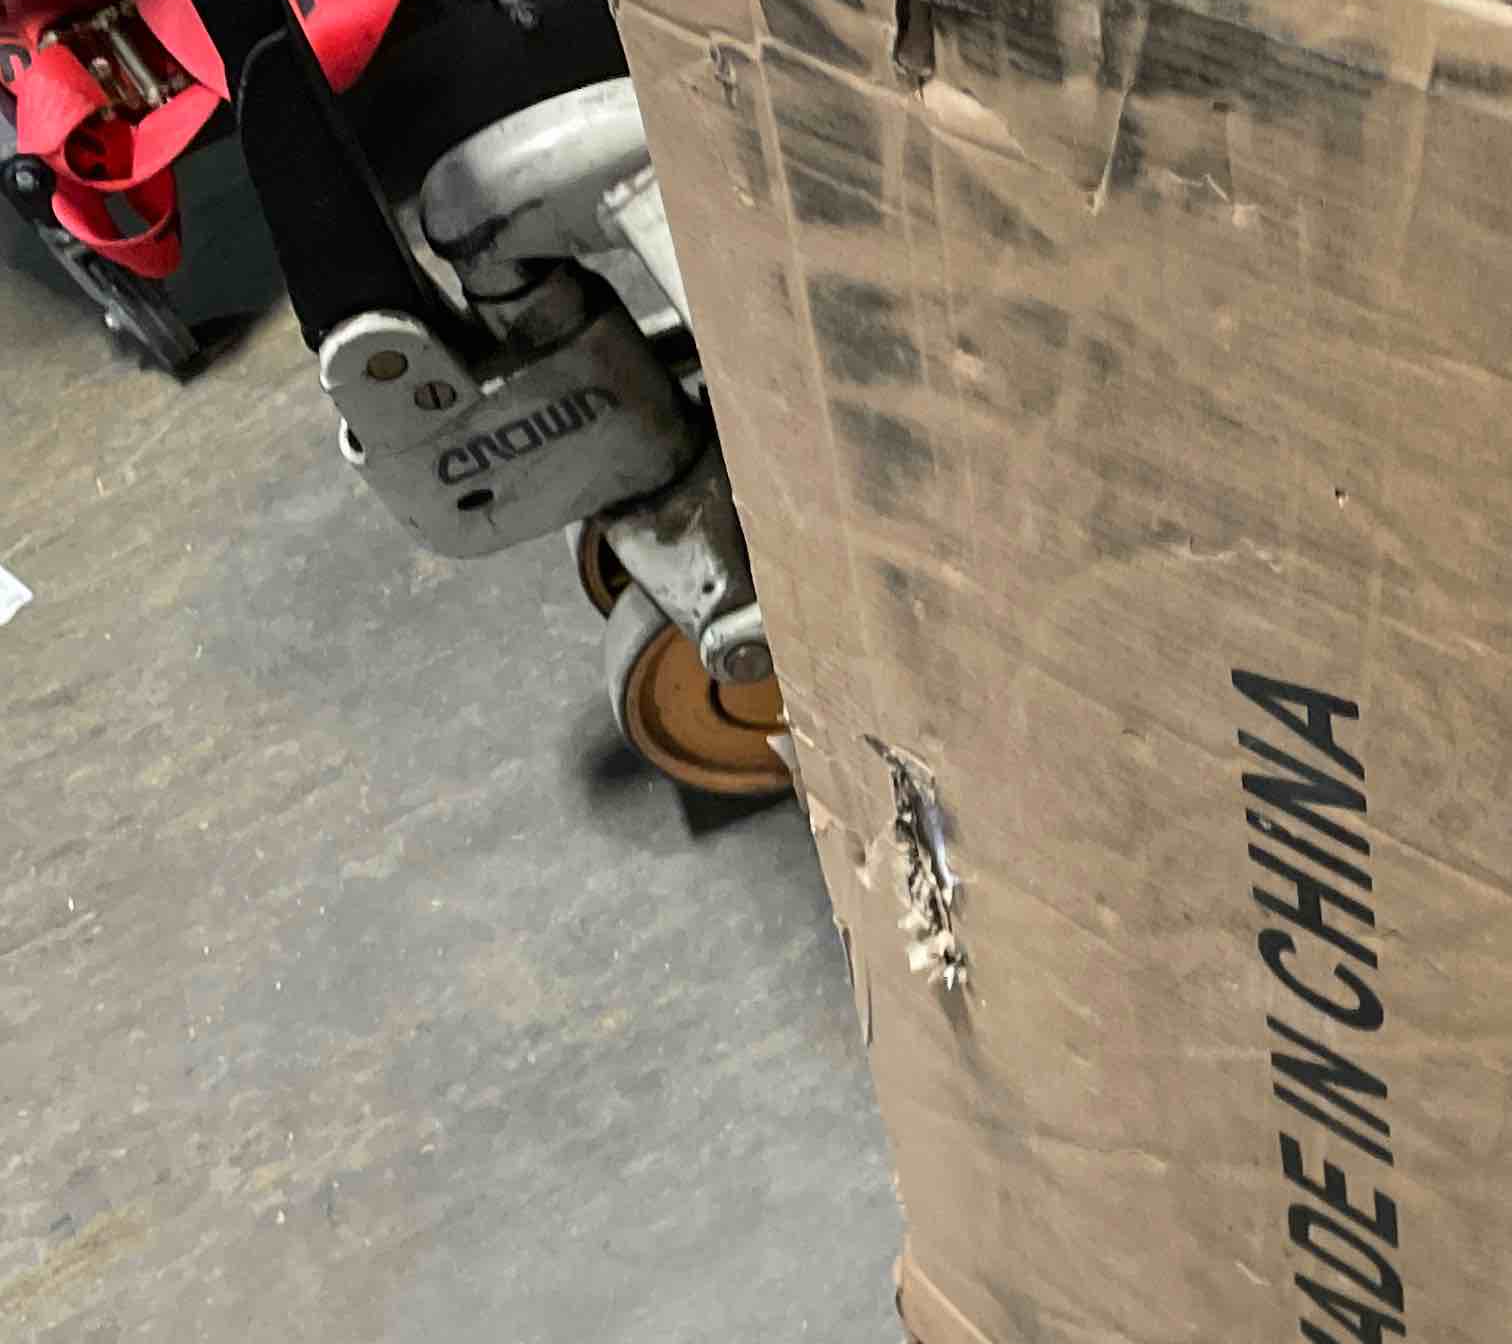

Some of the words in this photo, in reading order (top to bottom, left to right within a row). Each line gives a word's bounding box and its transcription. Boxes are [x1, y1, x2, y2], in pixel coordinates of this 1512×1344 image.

[439, 387, 622, 486] CROWN
[1231, 666, 1386, 1034] CHINA
[1266, 1015, 1395, 1166] IN
